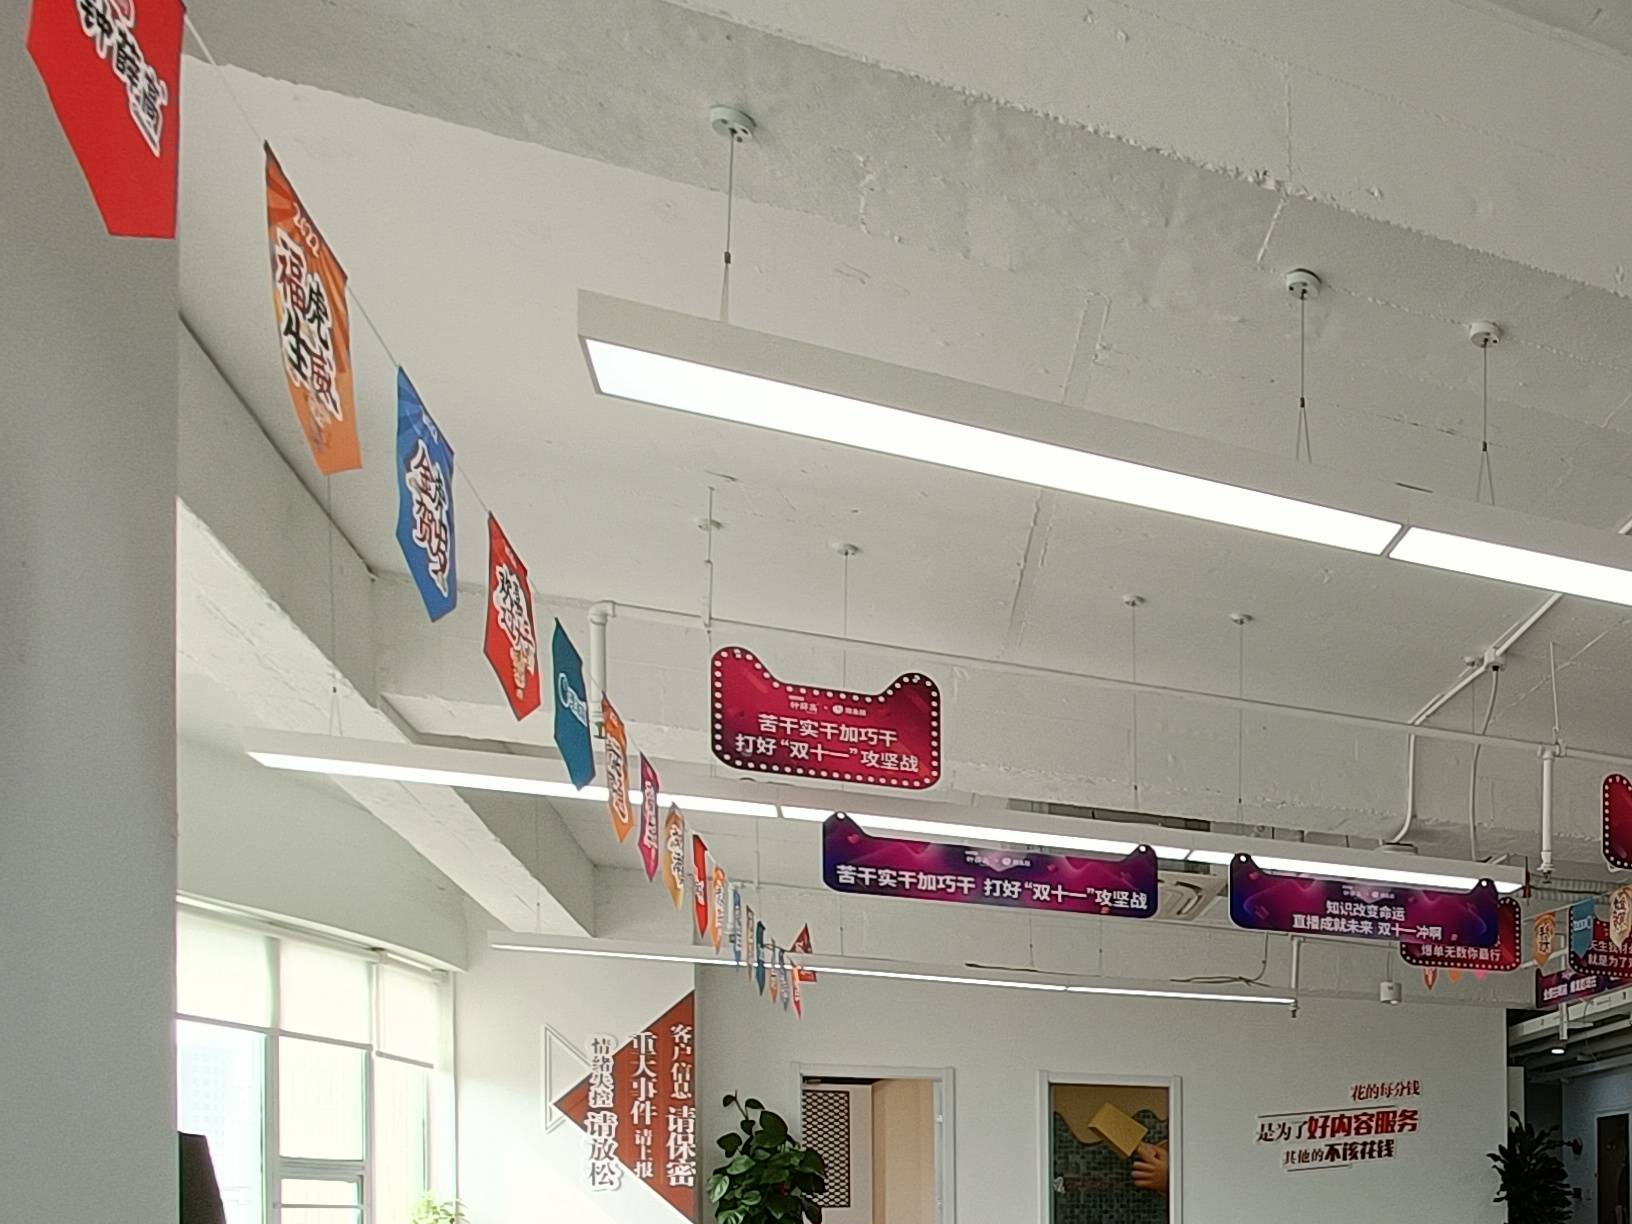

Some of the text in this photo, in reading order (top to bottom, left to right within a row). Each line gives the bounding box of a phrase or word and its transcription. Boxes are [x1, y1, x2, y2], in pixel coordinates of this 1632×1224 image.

[758, 714, 897, 747] 苦干实干加巧干
[836, 864, 976, 895] 苦干实干加巧干
[1292, 914, 1374, 935] 直播成就未来
[1326, 900, 1406, 921] 知识改变命运
[629, 1031, 659, 1179] 重大事件 请上报
[665, 1023, 697, 1188] 客户信息 请保密
[1351, 1079, 1421, 1101] 花的每分钱
[584, 1037, 618, 1187] 情绪失控 请放松
[1256, 1109, 1419, 1143] 是为了好内容服务
[1284, 1139, 1395, 1165] 其他的不该花钱
